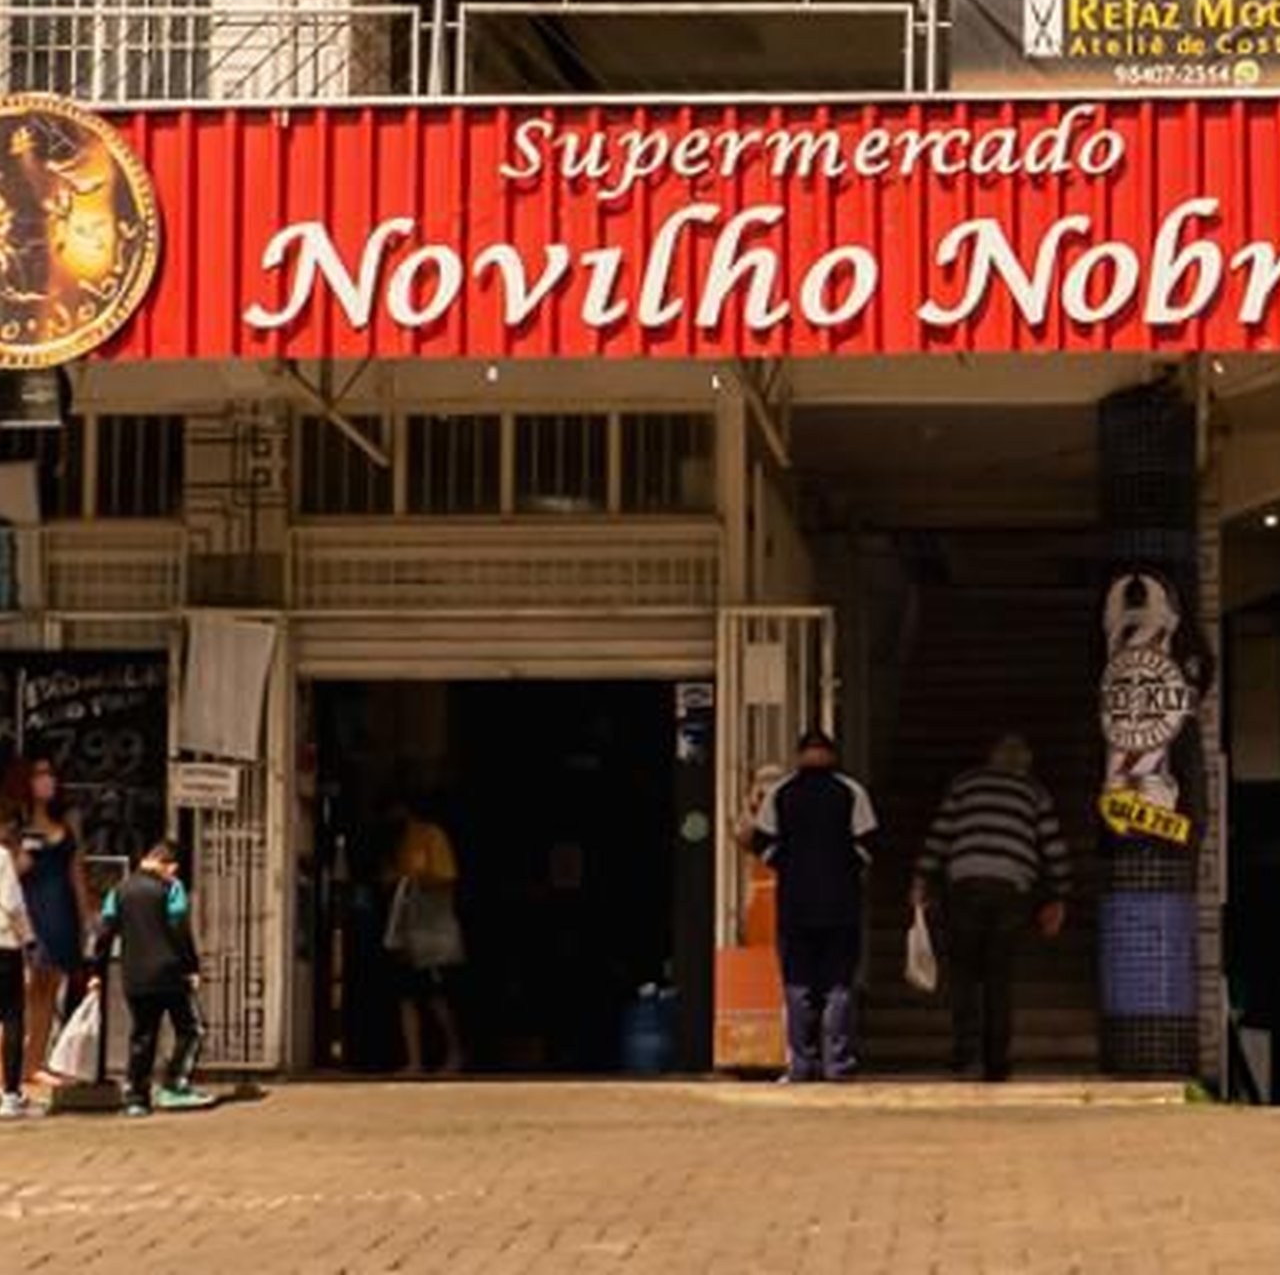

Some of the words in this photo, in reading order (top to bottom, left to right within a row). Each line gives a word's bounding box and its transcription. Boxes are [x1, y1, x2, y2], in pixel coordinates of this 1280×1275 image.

[1177, 34, 1205, 54] de
[499, 103, 1127, 202] Supermercado
[242, 201, 880, 330] Novilho
